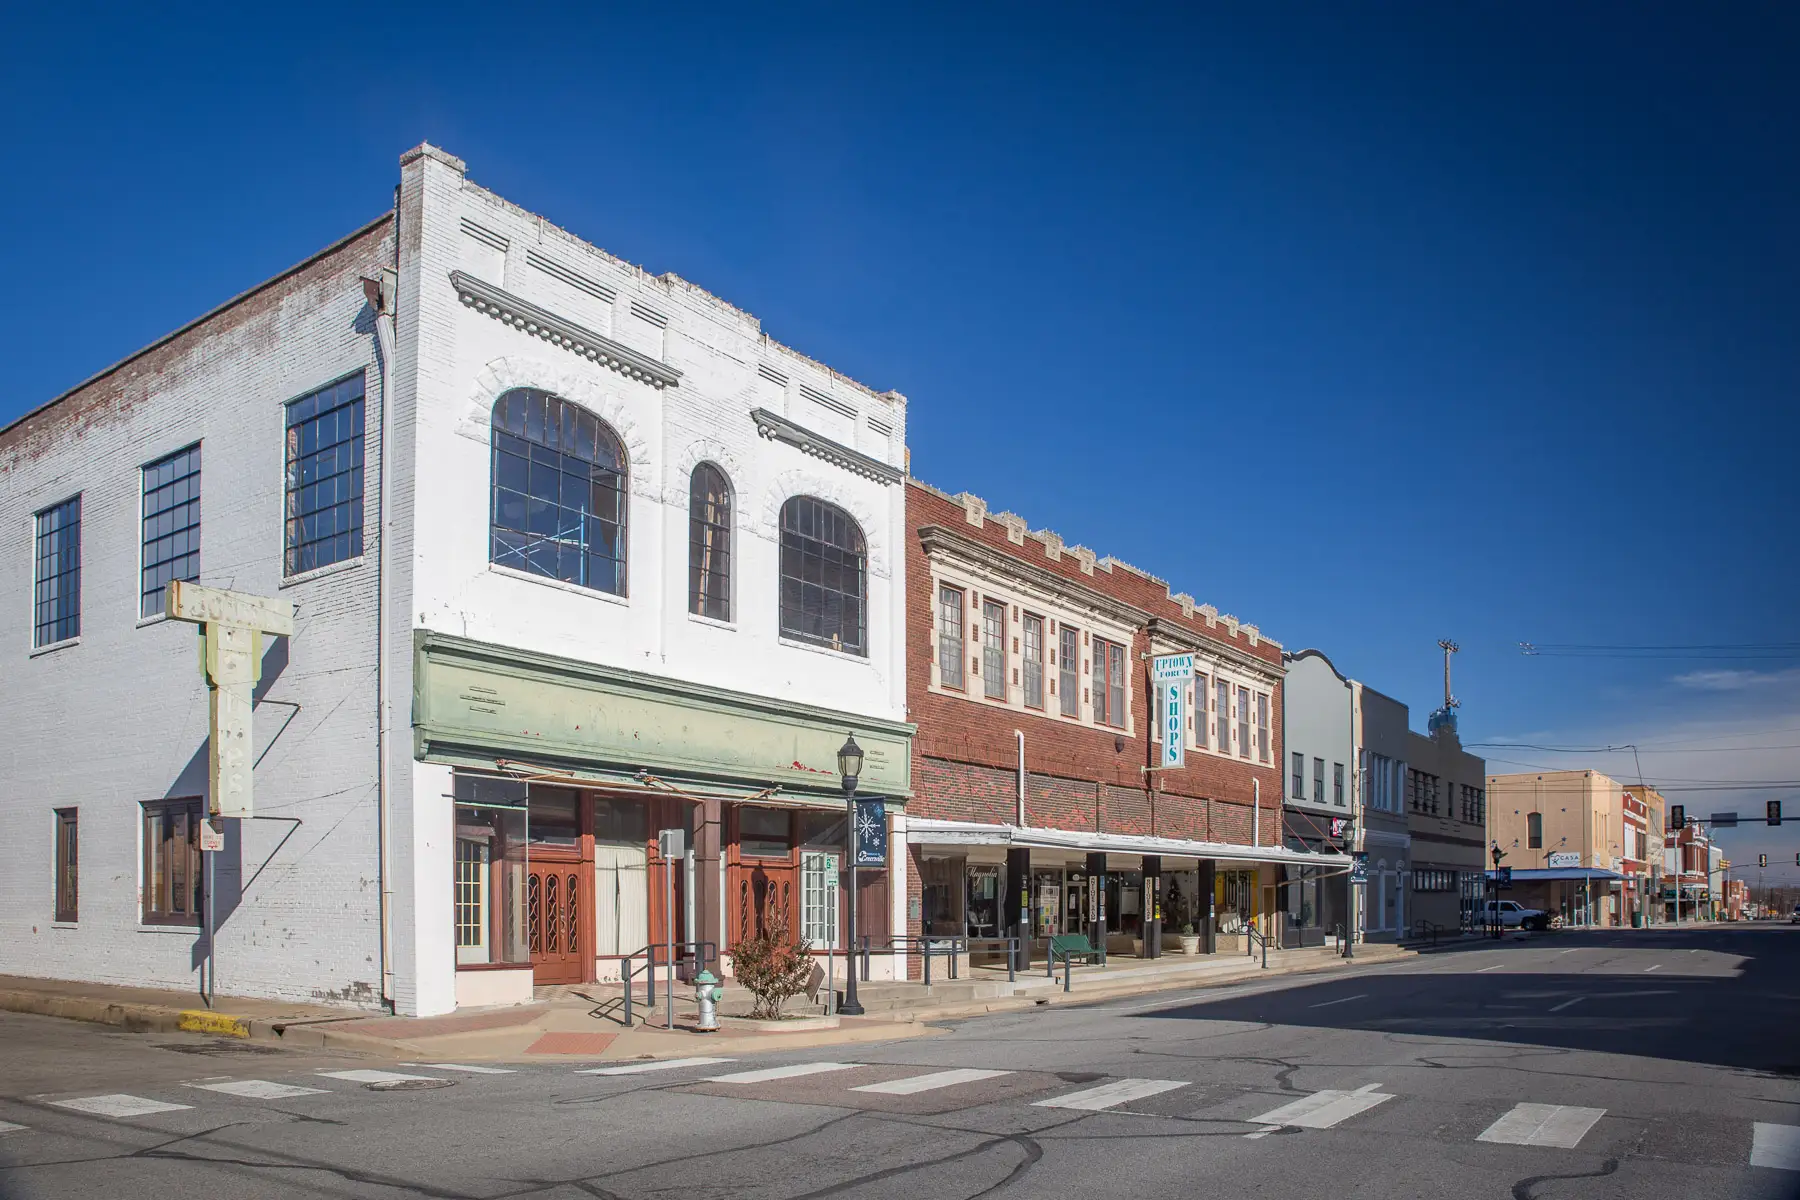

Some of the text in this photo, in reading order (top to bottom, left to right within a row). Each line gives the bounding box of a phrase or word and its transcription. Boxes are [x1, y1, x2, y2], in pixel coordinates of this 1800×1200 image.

[1156, 655, 1193, 672] UPTOWN
[1160, 670, 1189, 678] FORUM
[1168, 686, 1179, 762] SHOPS
[967, 866, 998, 886] Magnolia
